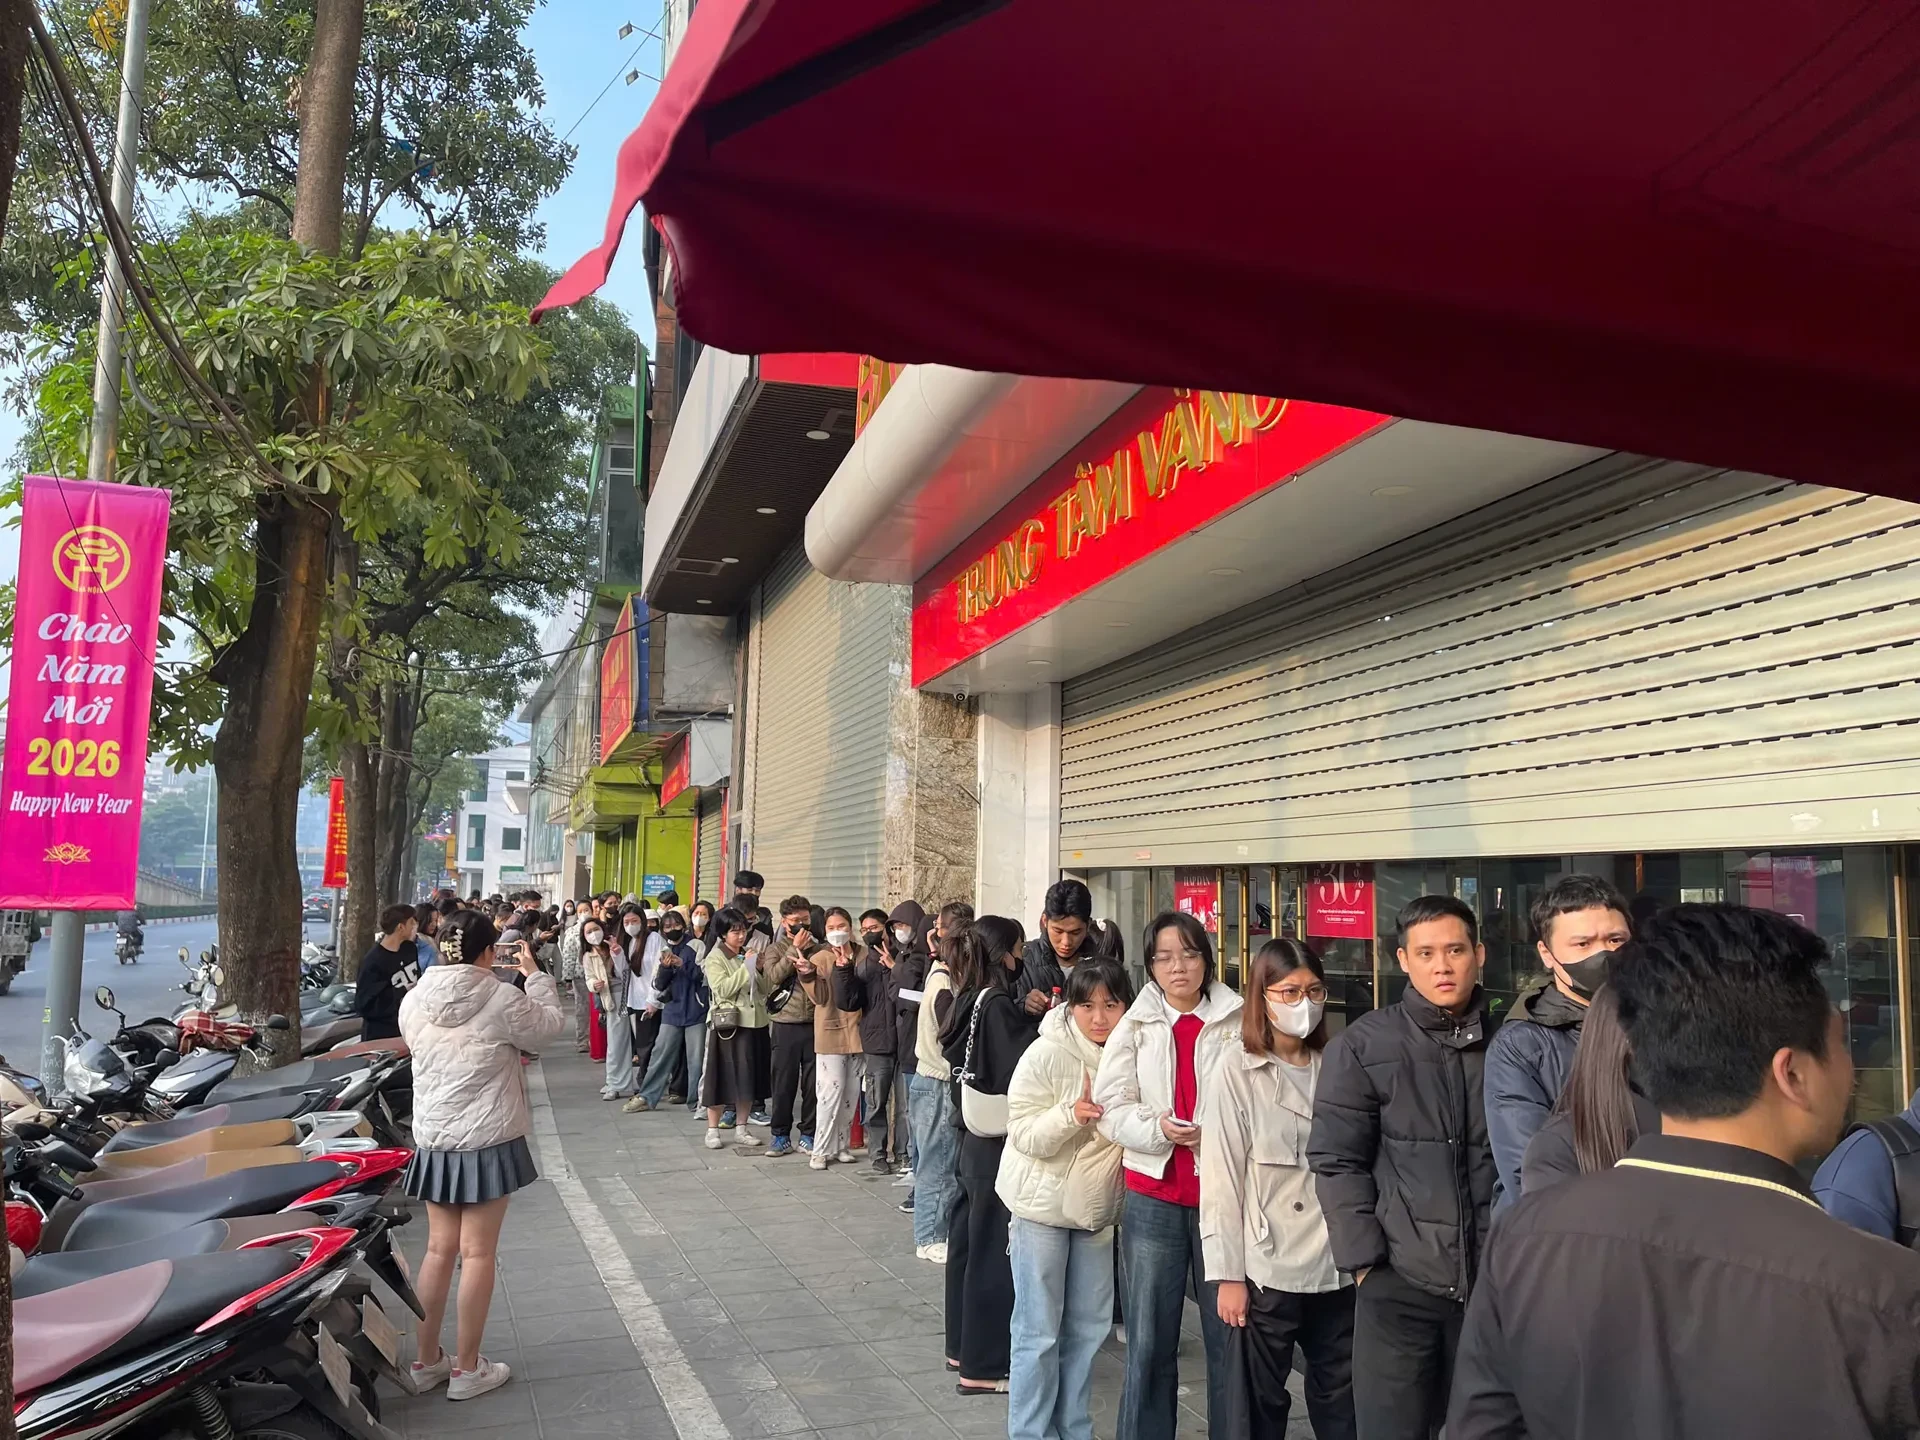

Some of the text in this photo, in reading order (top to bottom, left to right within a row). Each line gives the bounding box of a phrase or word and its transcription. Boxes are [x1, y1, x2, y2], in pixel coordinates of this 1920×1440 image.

[951, 519, 1045, 625] TRUNG
[1047, 450, 1132, 560] TÂM
[38, 612, 132, 644] Chào
[37, 654, 126, 685] Năm
[42, 695, 114, 725] Mới
[27, 737, 120, 777] 2026
[10, 790, 133, 817] Happy New Year
